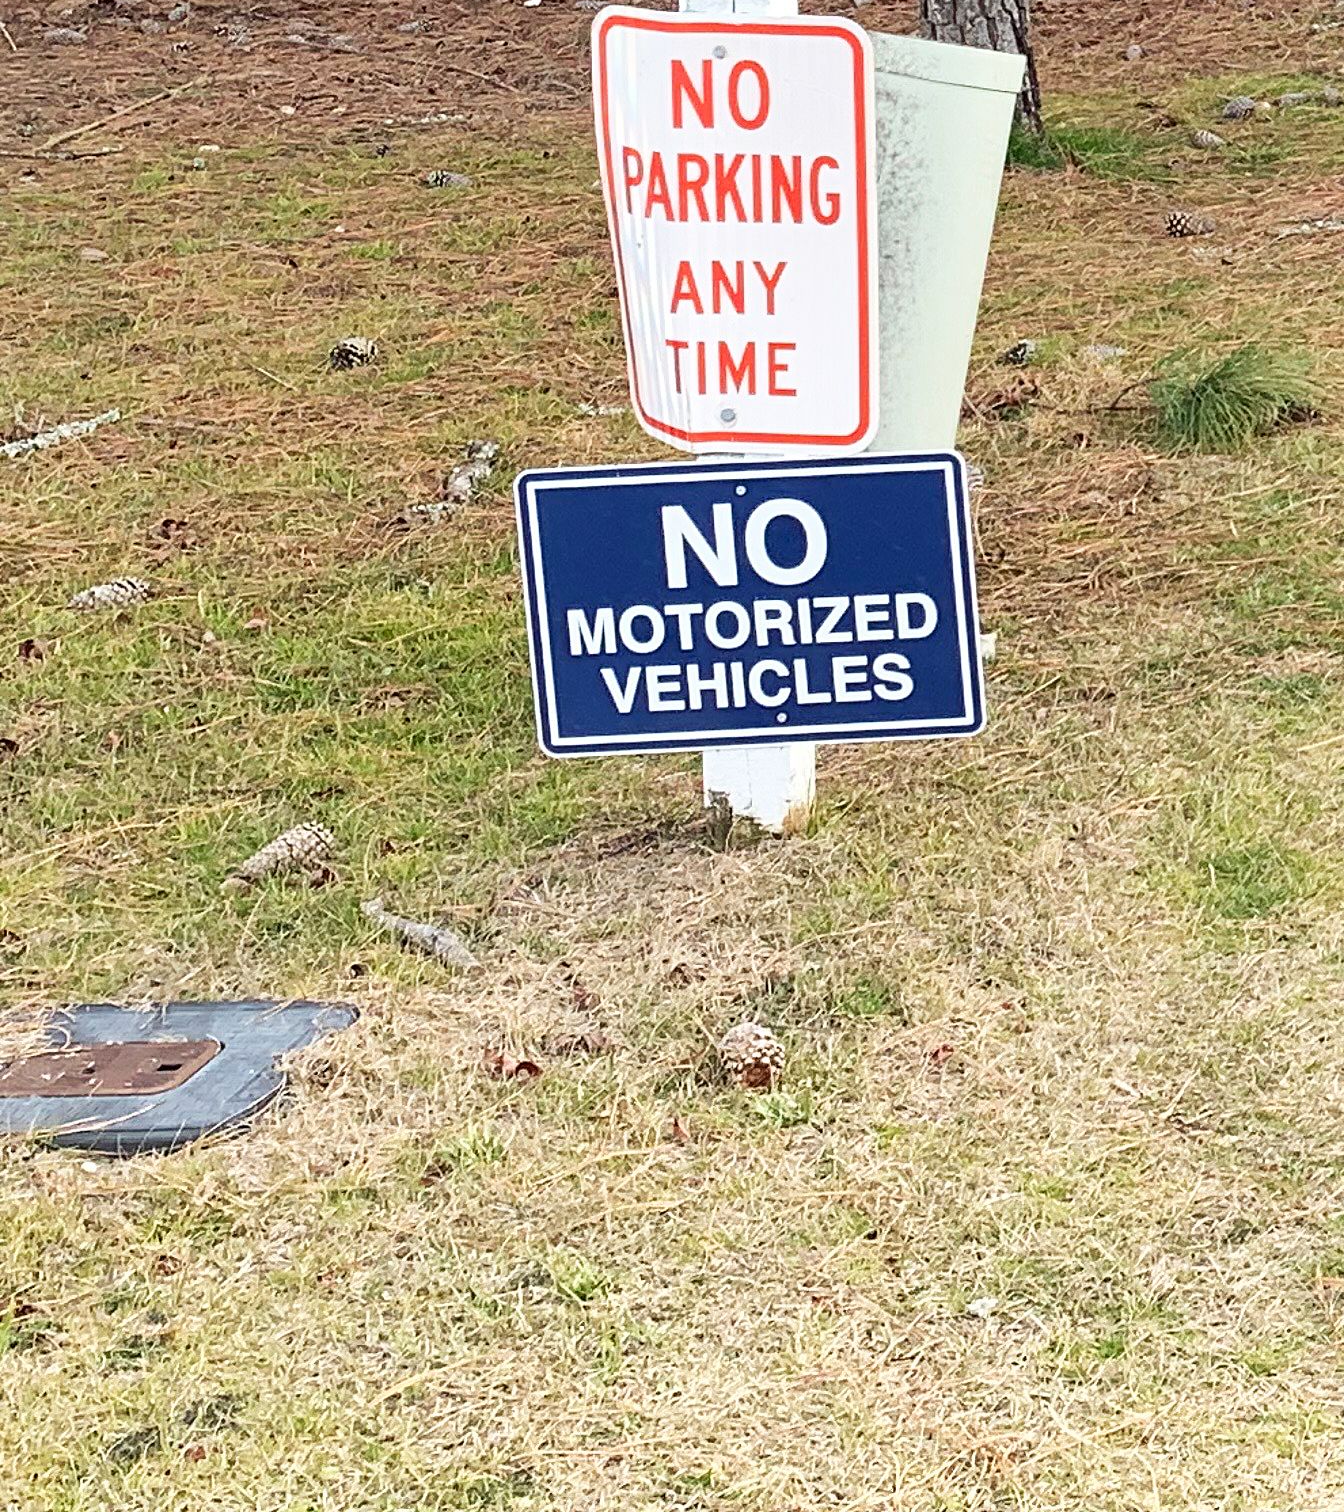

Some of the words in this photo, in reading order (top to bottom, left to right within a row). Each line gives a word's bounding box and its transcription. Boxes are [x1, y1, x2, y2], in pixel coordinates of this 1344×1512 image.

[671, 59, 770, 131] NO
[622, 146, 841, 226] PARKING
[670, 259, 788, 316] ANY
[665, 338, 798, 397] TIME
[660, 497, 828, 590] NO
[566, 592, 939, 657] MOTORIZED
[600, 653, 915, 715] VEHICLES
